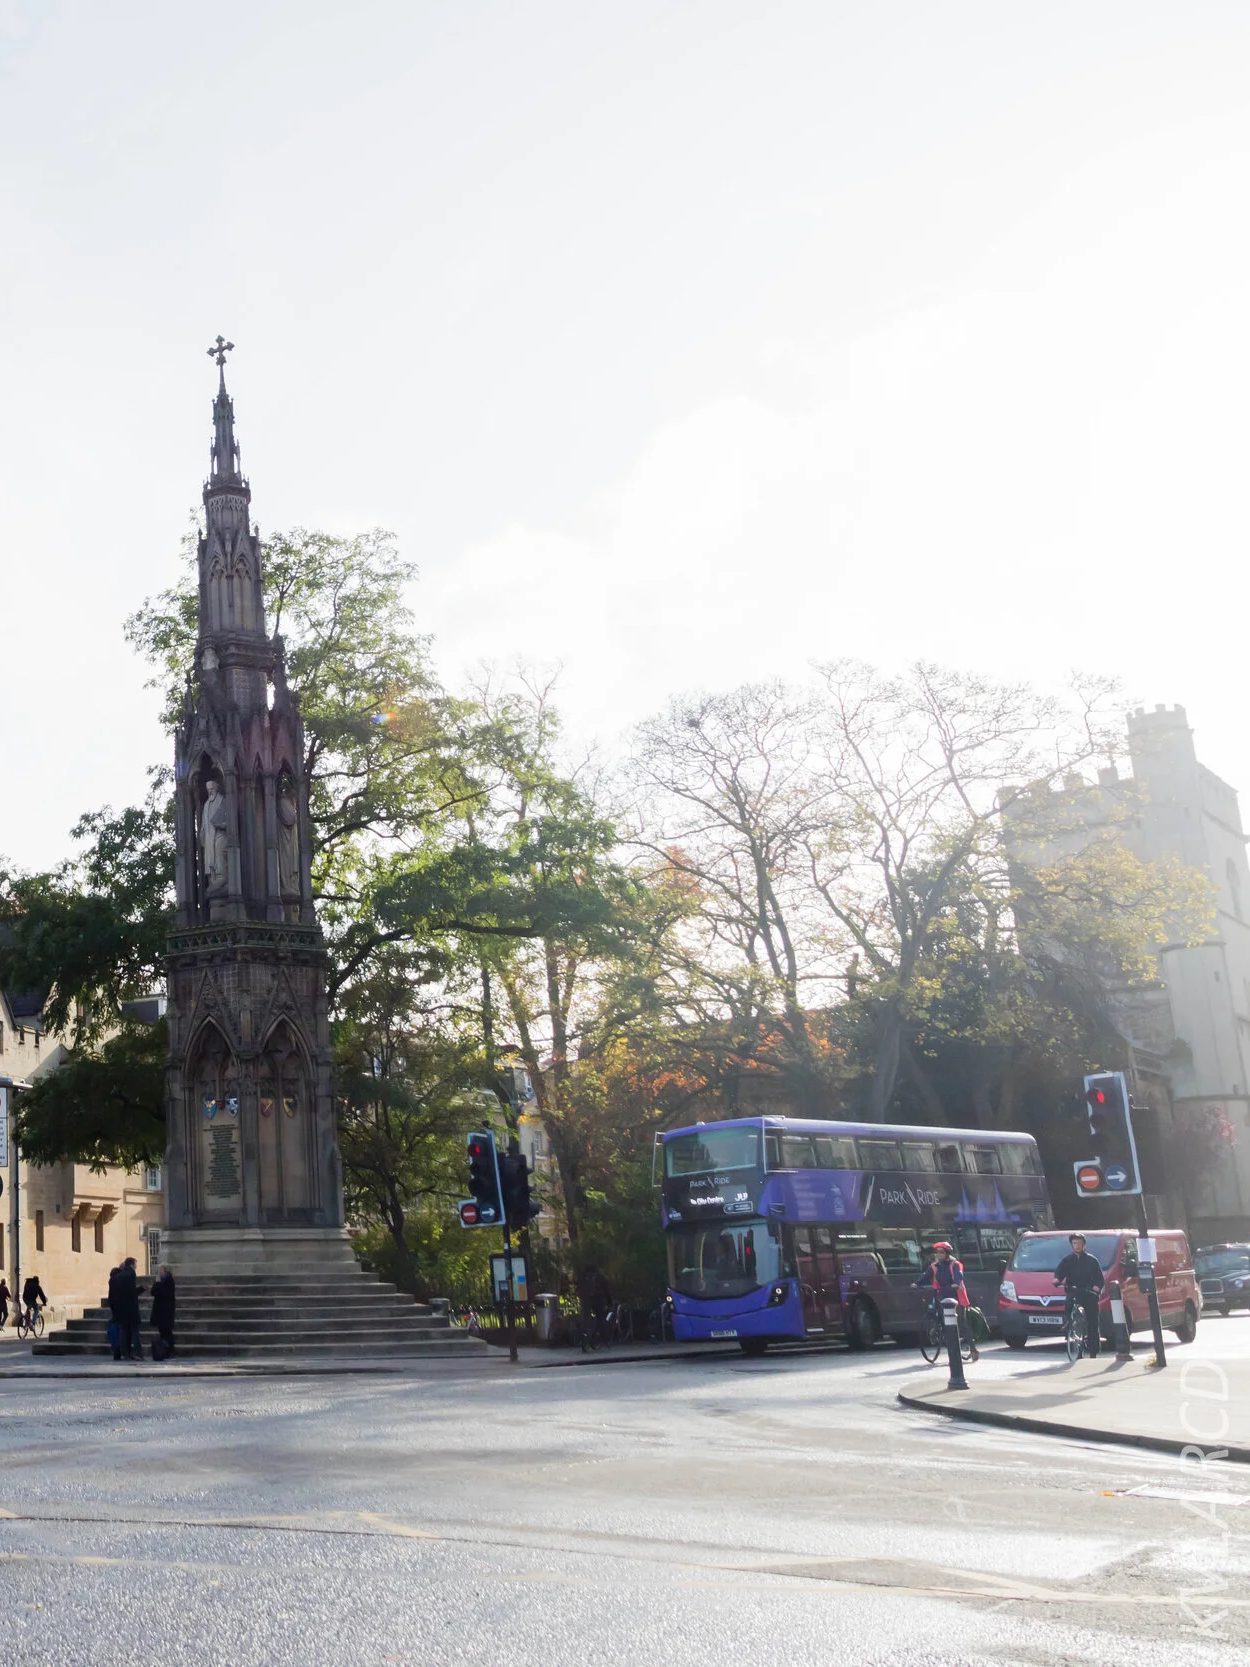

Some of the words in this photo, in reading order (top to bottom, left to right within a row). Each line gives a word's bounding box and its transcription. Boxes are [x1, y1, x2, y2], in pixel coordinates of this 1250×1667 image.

[713, 1177, 730, 1185] RIDE
[879, 1188, 908, 1205] PARK
[916, 1188, 941, 1205] RIDE
